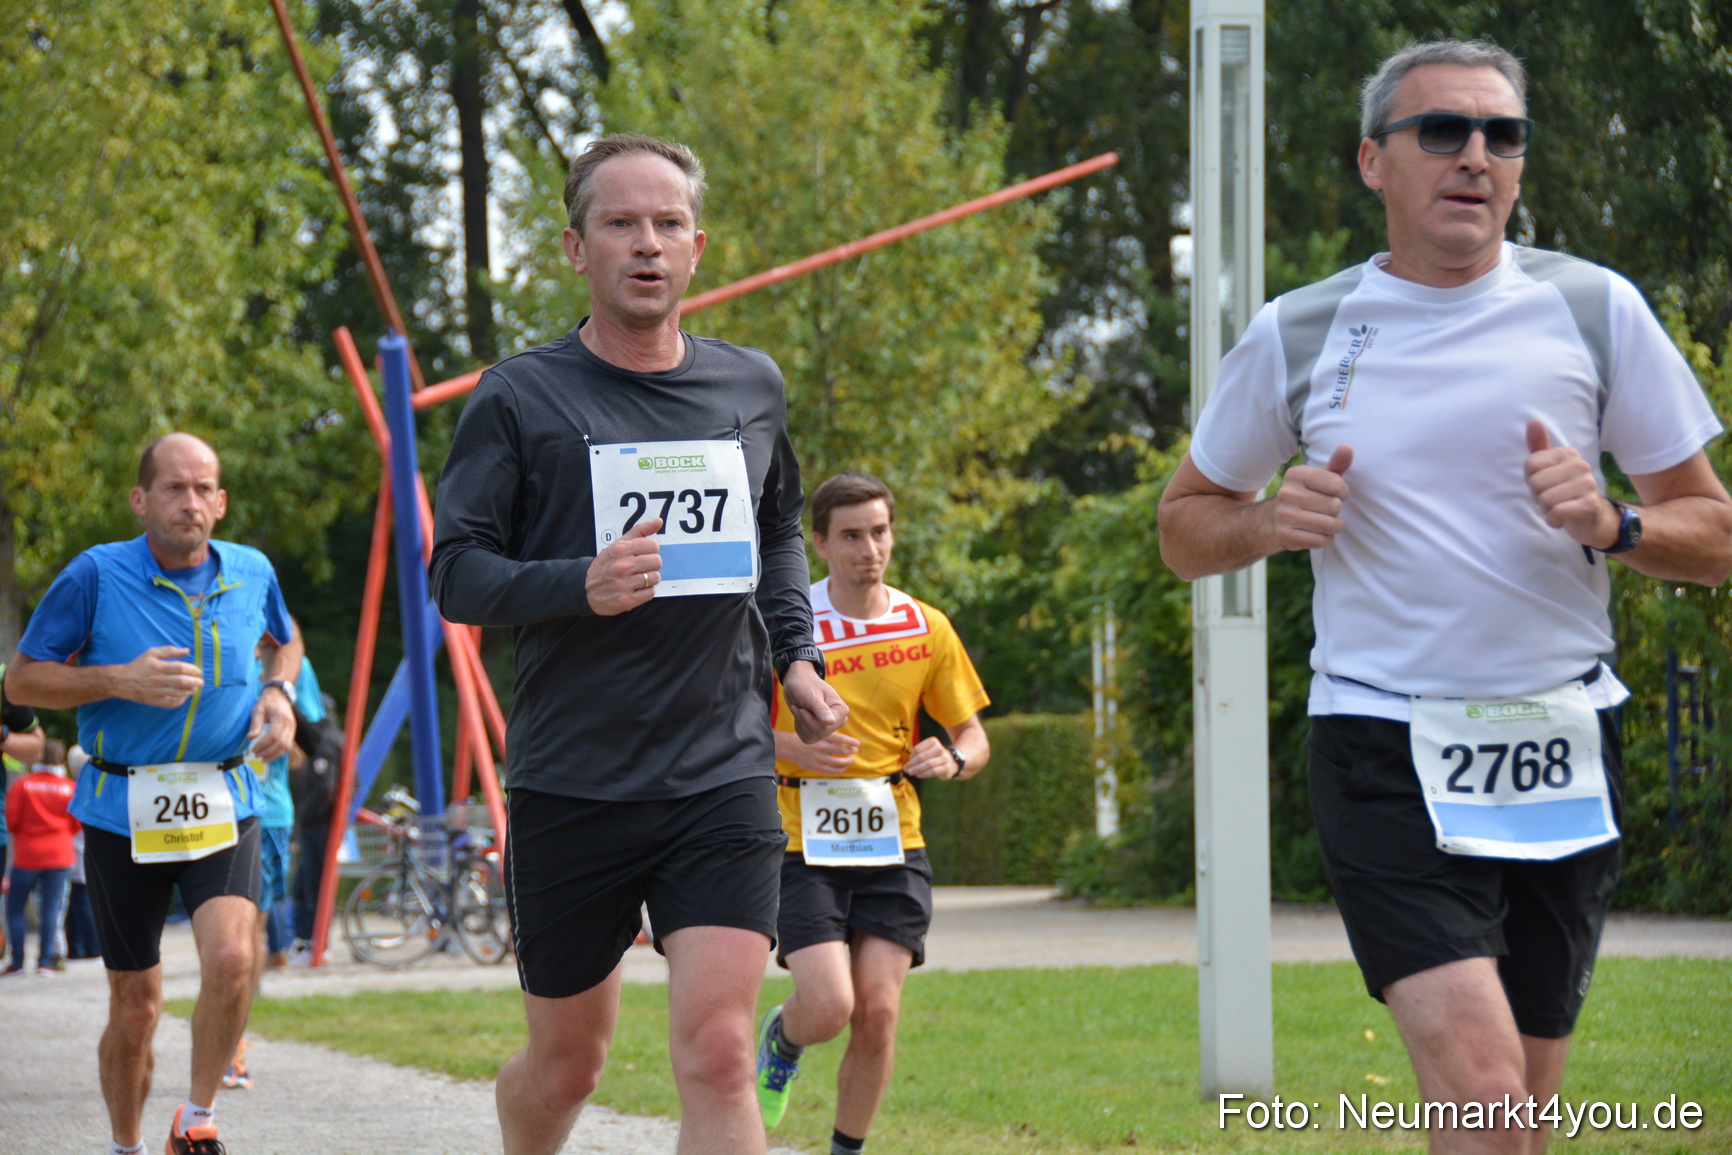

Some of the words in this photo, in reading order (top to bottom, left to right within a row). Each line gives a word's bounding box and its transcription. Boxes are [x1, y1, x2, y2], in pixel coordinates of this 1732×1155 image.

[1329, 338, 1363, 410] SEEBERGER
[654, 455, 706, 469] BOCK
[619, 488, 729, 536] 2737
[605, 533, 612, 542] D
[872, 643, 932, 668] BÖGL
[1485, 701, 1549, 718] BOCK
[1441, 737, 1573, 794] 2768
[153, 792, 209, 824] 246
[815, 806, 884, 834] 2616
[164, 831, 204, 845] Christof
[831, 842, 874, 854] Matthias
